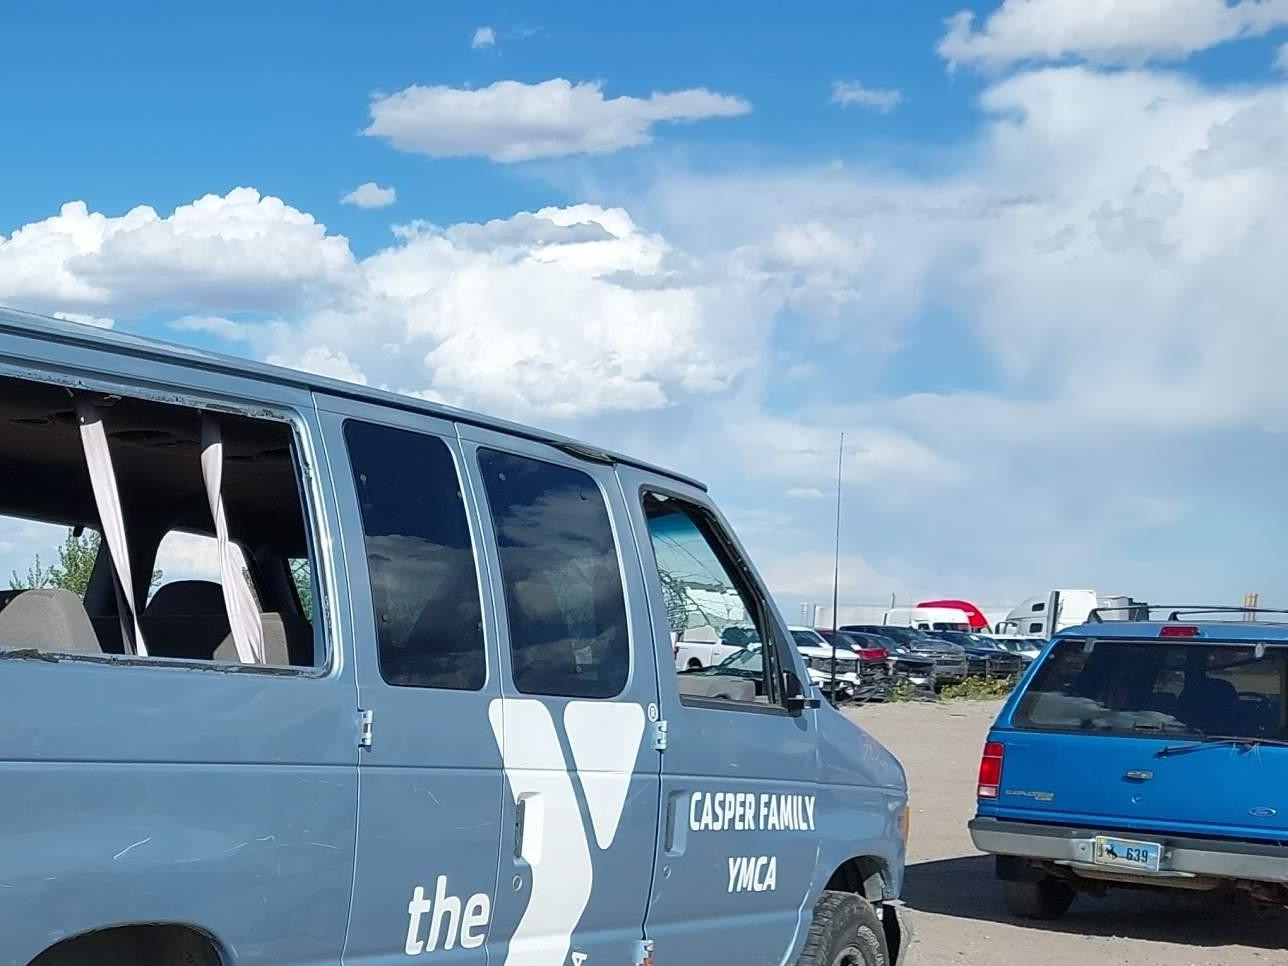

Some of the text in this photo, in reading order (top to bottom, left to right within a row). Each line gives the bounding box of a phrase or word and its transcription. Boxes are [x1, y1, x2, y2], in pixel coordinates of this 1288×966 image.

[689, 791, 816, 831] CASPER FAMILY
[728, 855, 777, 893] YMCA
[1126, 847, 1149, 863] 639
[403, 874, 491, 957] the
